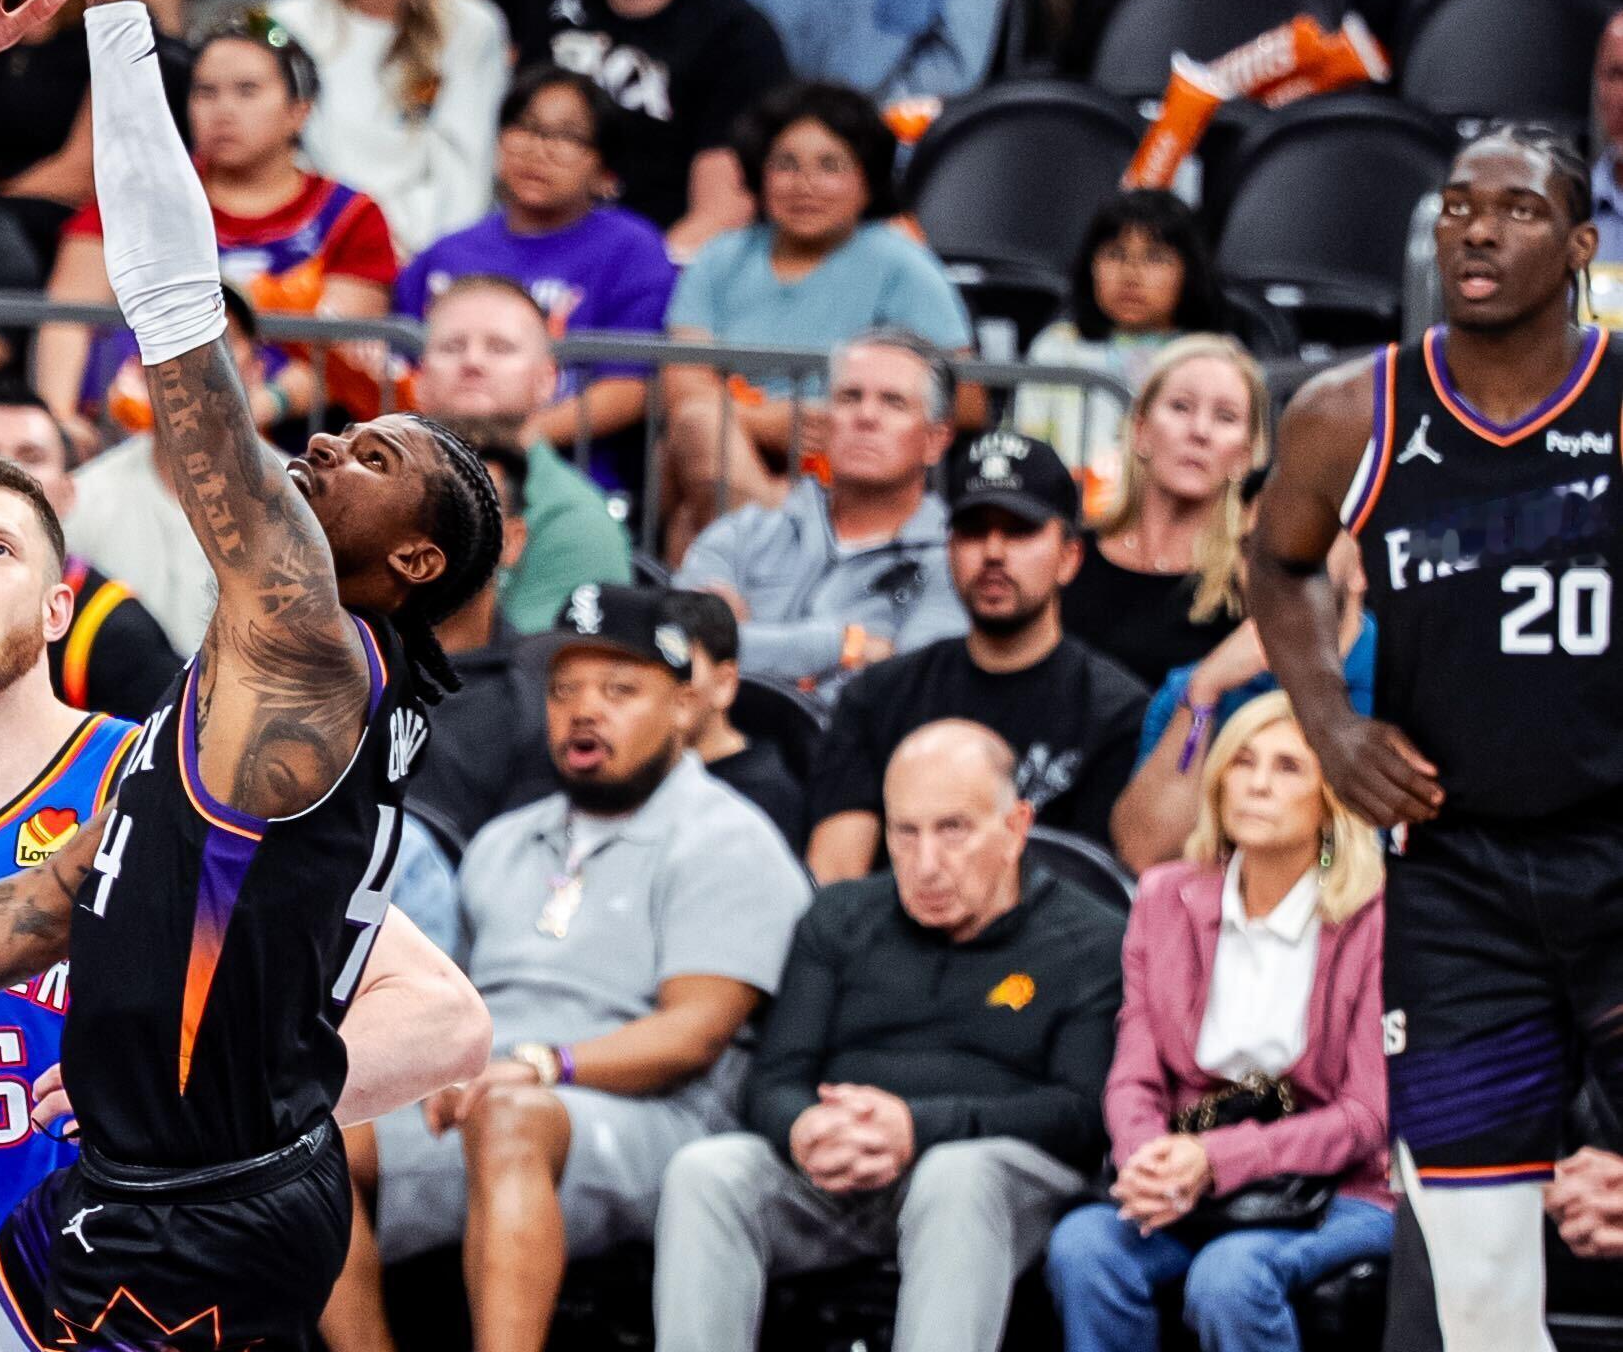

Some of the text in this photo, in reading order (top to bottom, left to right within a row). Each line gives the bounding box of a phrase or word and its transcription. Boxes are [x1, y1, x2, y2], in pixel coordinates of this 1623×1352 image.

[1545, 429, 1614, 458] PayPal
[1500, 566, 1612, 657] 20
[20, 845, 59, 863] Lov
[90, 808, 135, 919] 4
